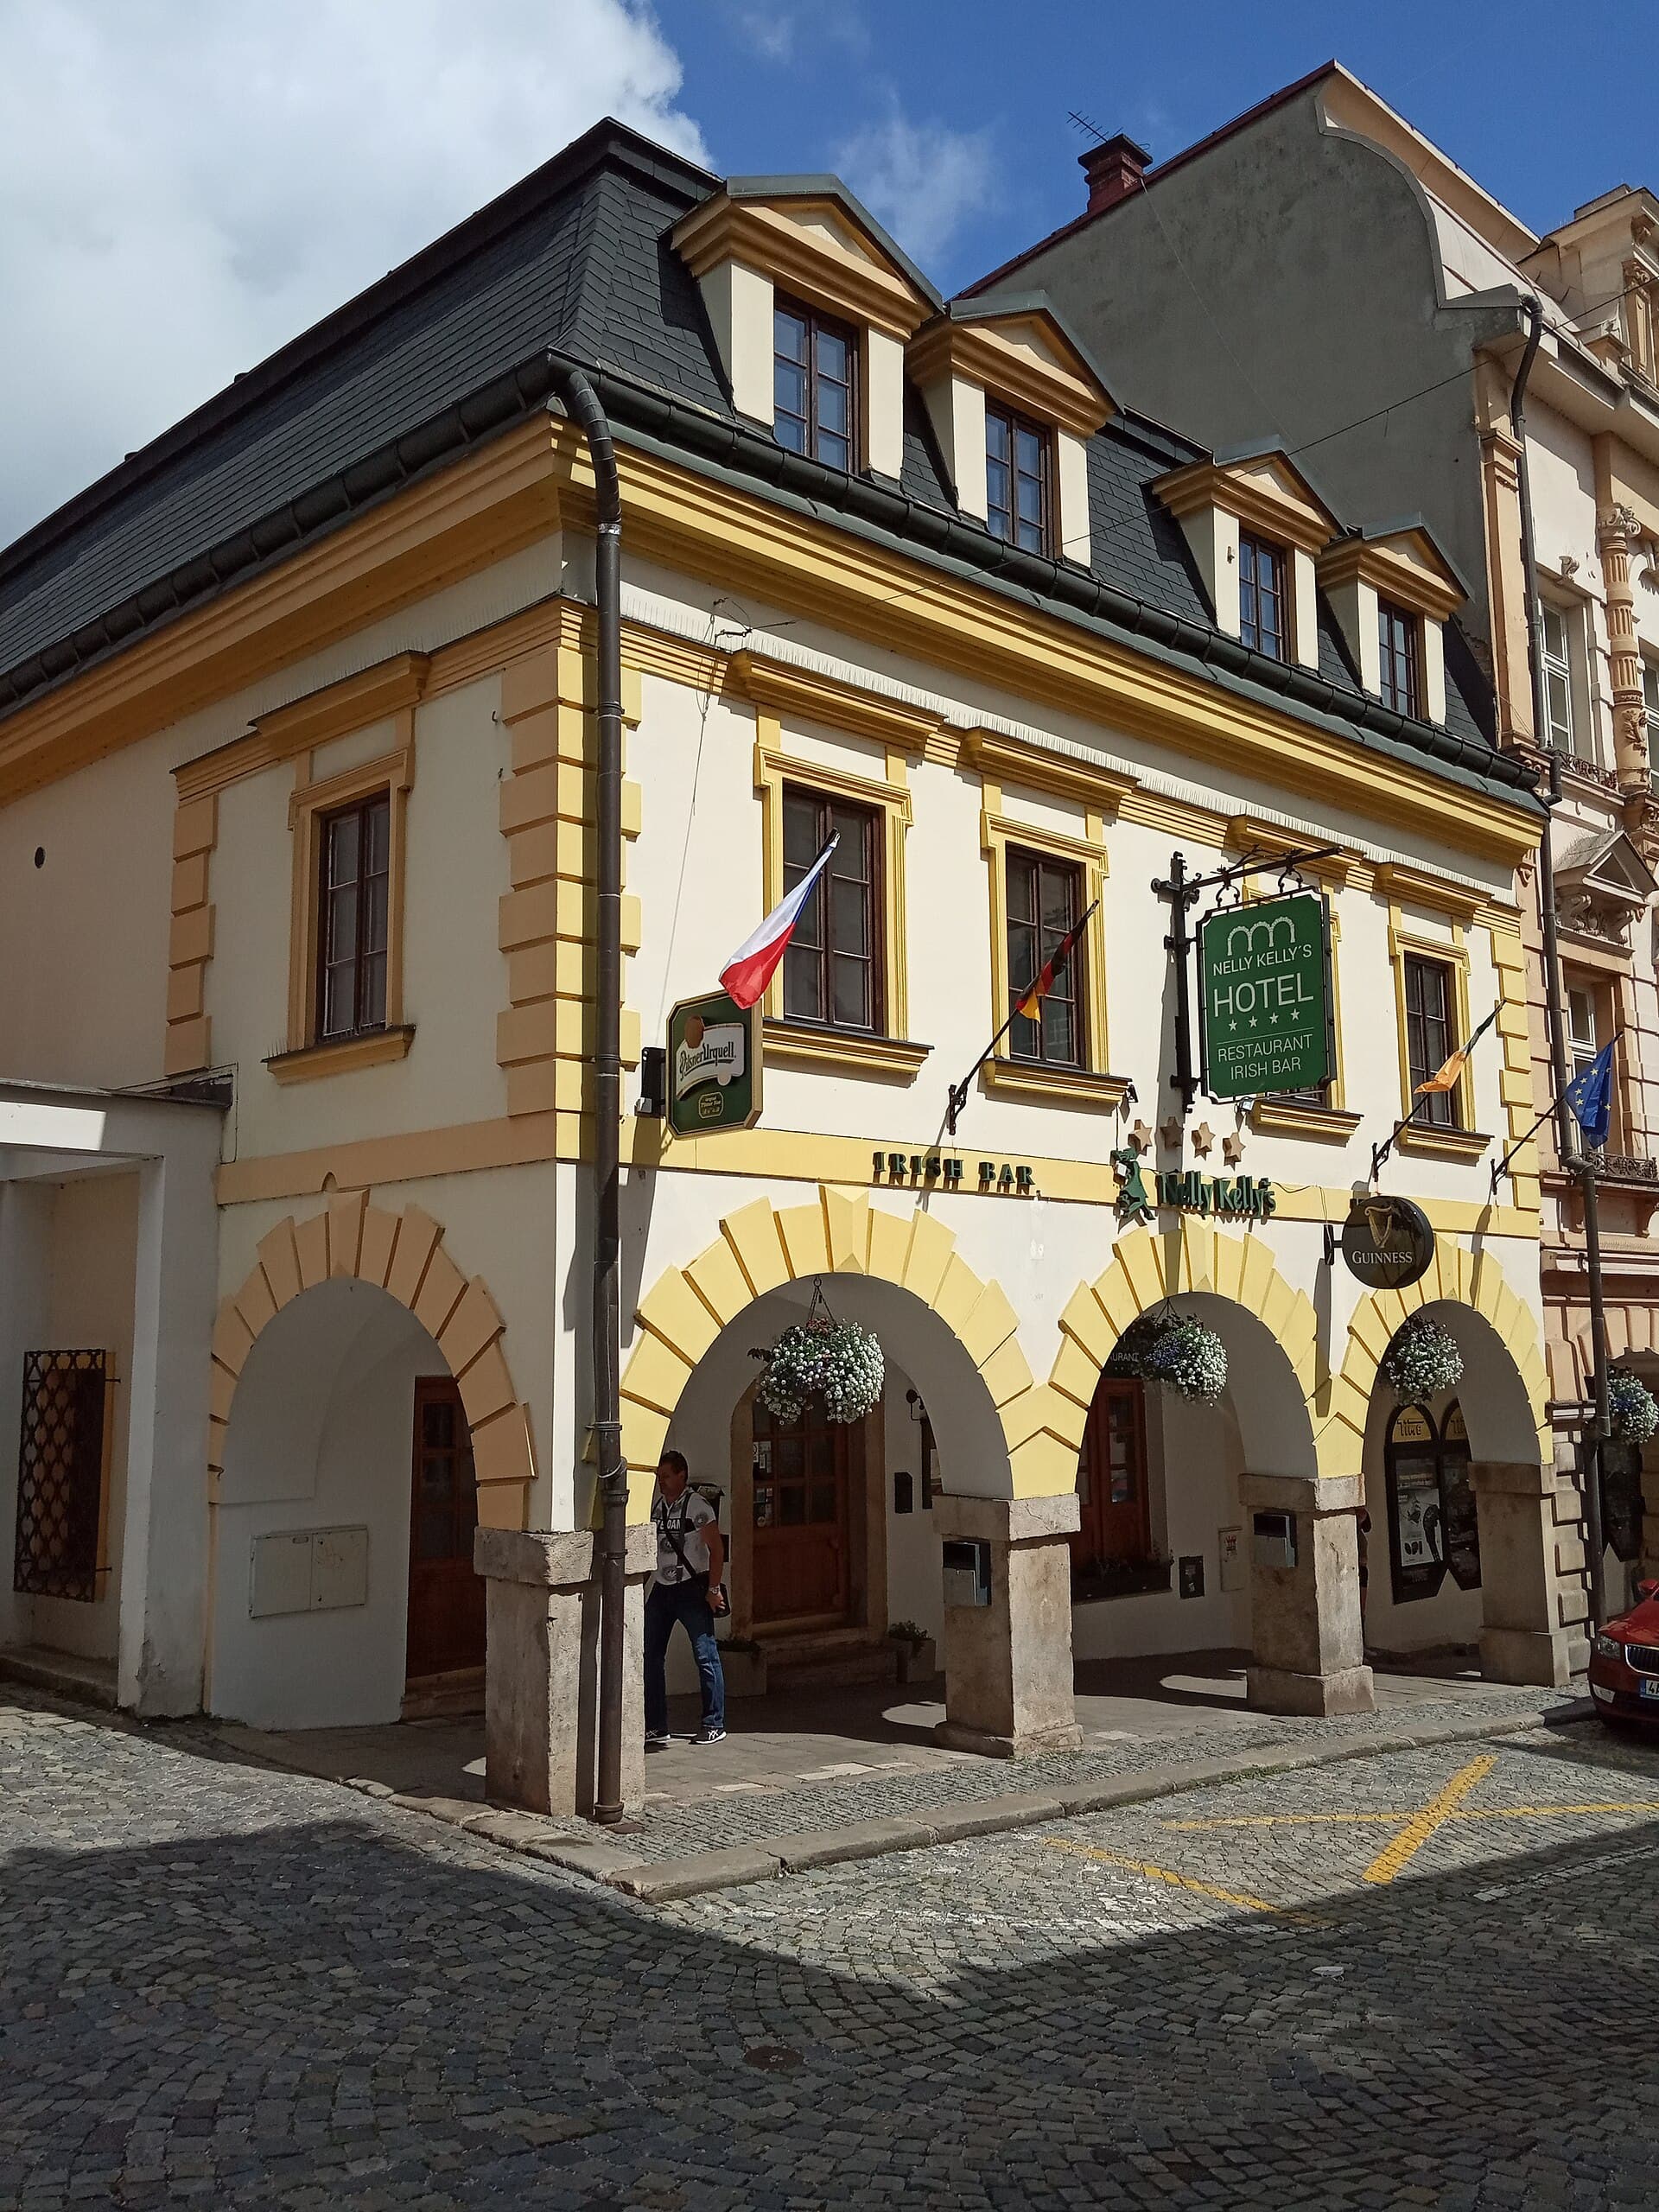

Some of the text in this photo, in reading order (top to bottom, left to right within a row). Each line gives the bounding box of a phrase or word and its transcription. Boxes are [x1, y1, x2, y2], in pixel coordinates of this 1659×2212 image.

[1213, 956, 1253, 976] NELLY
[1213, 972, 1314, 1018] HOTEL
[1217, 1033, 1313, 1063] RESTAURANT
[679, 1050, 703, 1081] Pilsner
[1230, 1056, 1301, 1080] IRISH BAR
[873, 1151, 1036, 1185] IRISH BAR
[1351, 1250, 1413, 1264] GUINNESS
